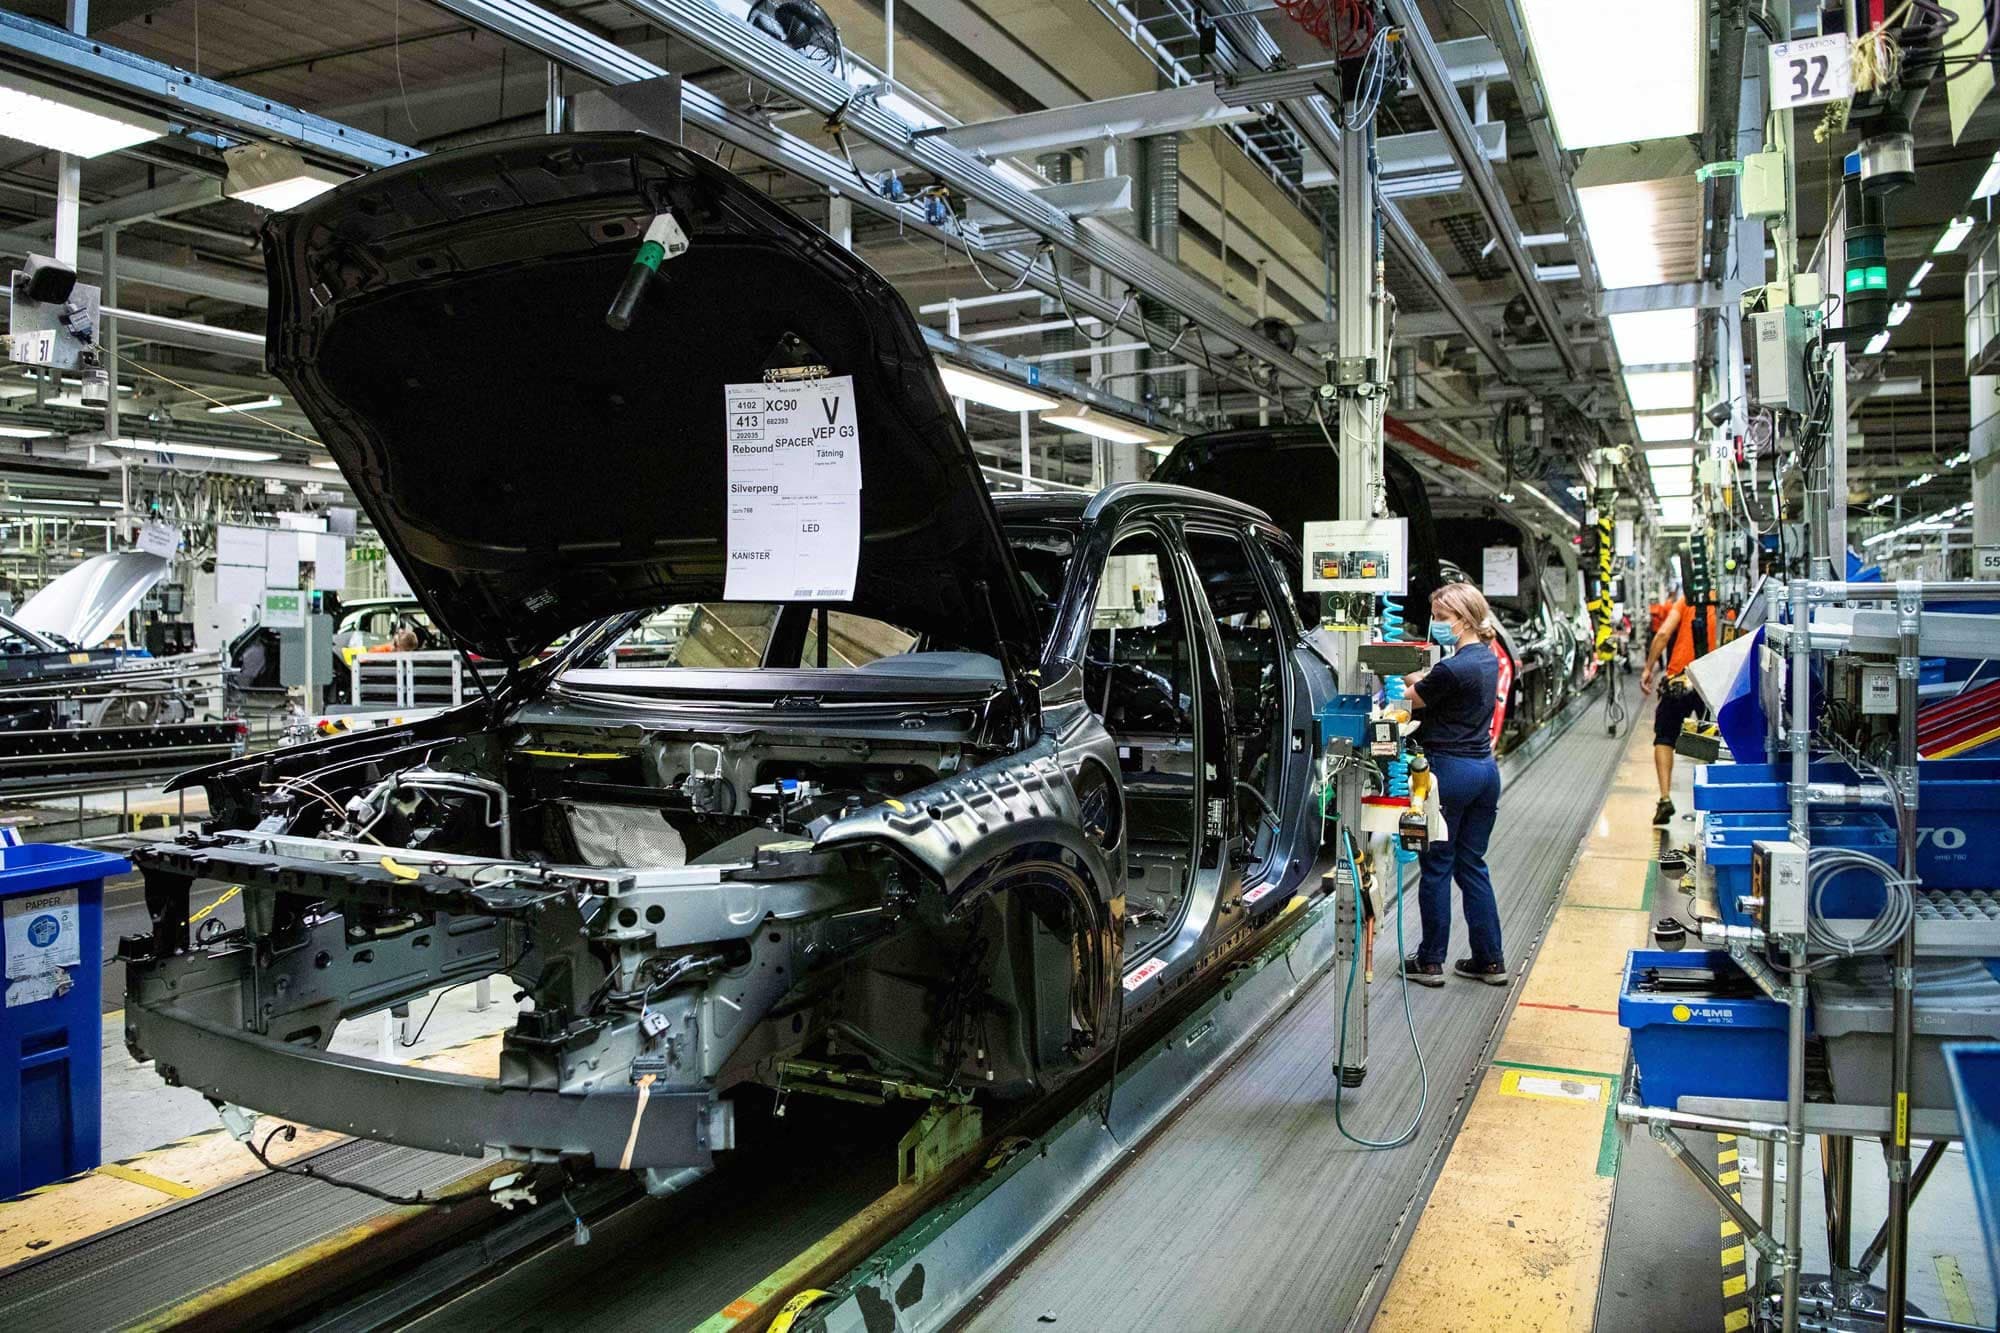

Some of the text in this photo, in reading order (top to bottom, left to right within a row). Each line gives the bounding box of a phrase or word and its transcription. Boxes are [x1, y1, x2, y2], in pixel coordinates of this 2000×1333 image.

[1798, 39, 1836, 51] STATION
[1789, 55, 1830, 102] 32
[39, 339, 49, 361] 31
[737, 401, 757, 409] 4102
[766, 399, 798, 412] XC90
[821, 396, 840, 425] V
[736, 415, 758, 427] 413
[812, 425, 855, 439] VEP G3
[732, 443, 774, 454] Rebound
[775, 437, 815, 448] SPACER
[731, 483, 779, 494] Silverpeng
[802, 523, 820, 533] LED
[731, 551, 770, 560] KANISTER
[26, 897, 60, 911] PAPPER
[1690, 1008, 1733, 1018] V-EMB
